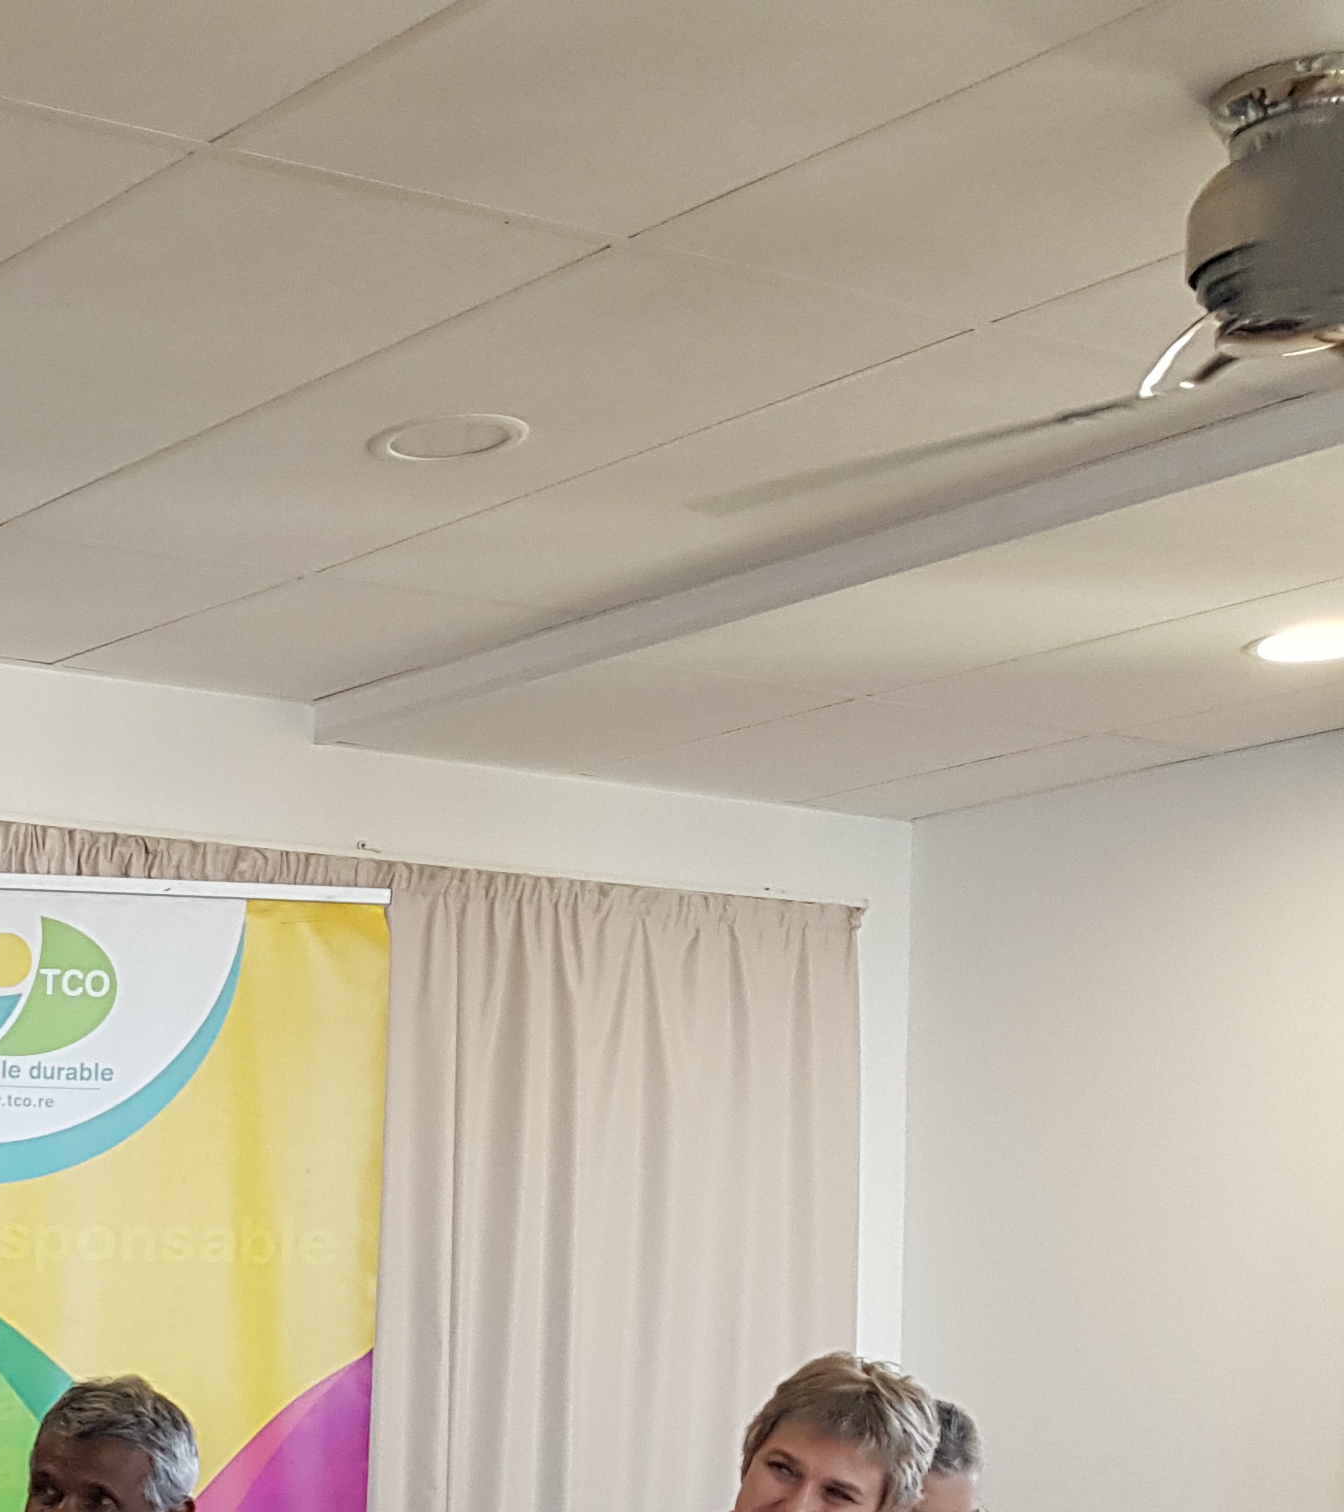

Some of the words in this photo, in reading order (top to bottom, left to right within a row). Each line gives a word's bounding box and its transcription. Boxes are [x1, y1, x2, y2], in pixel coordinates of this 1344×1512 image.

[40, 969, 110, 997] TCO
[1, 1060, 22, 1079] le
[29, 1061, 114, 1082] durable
